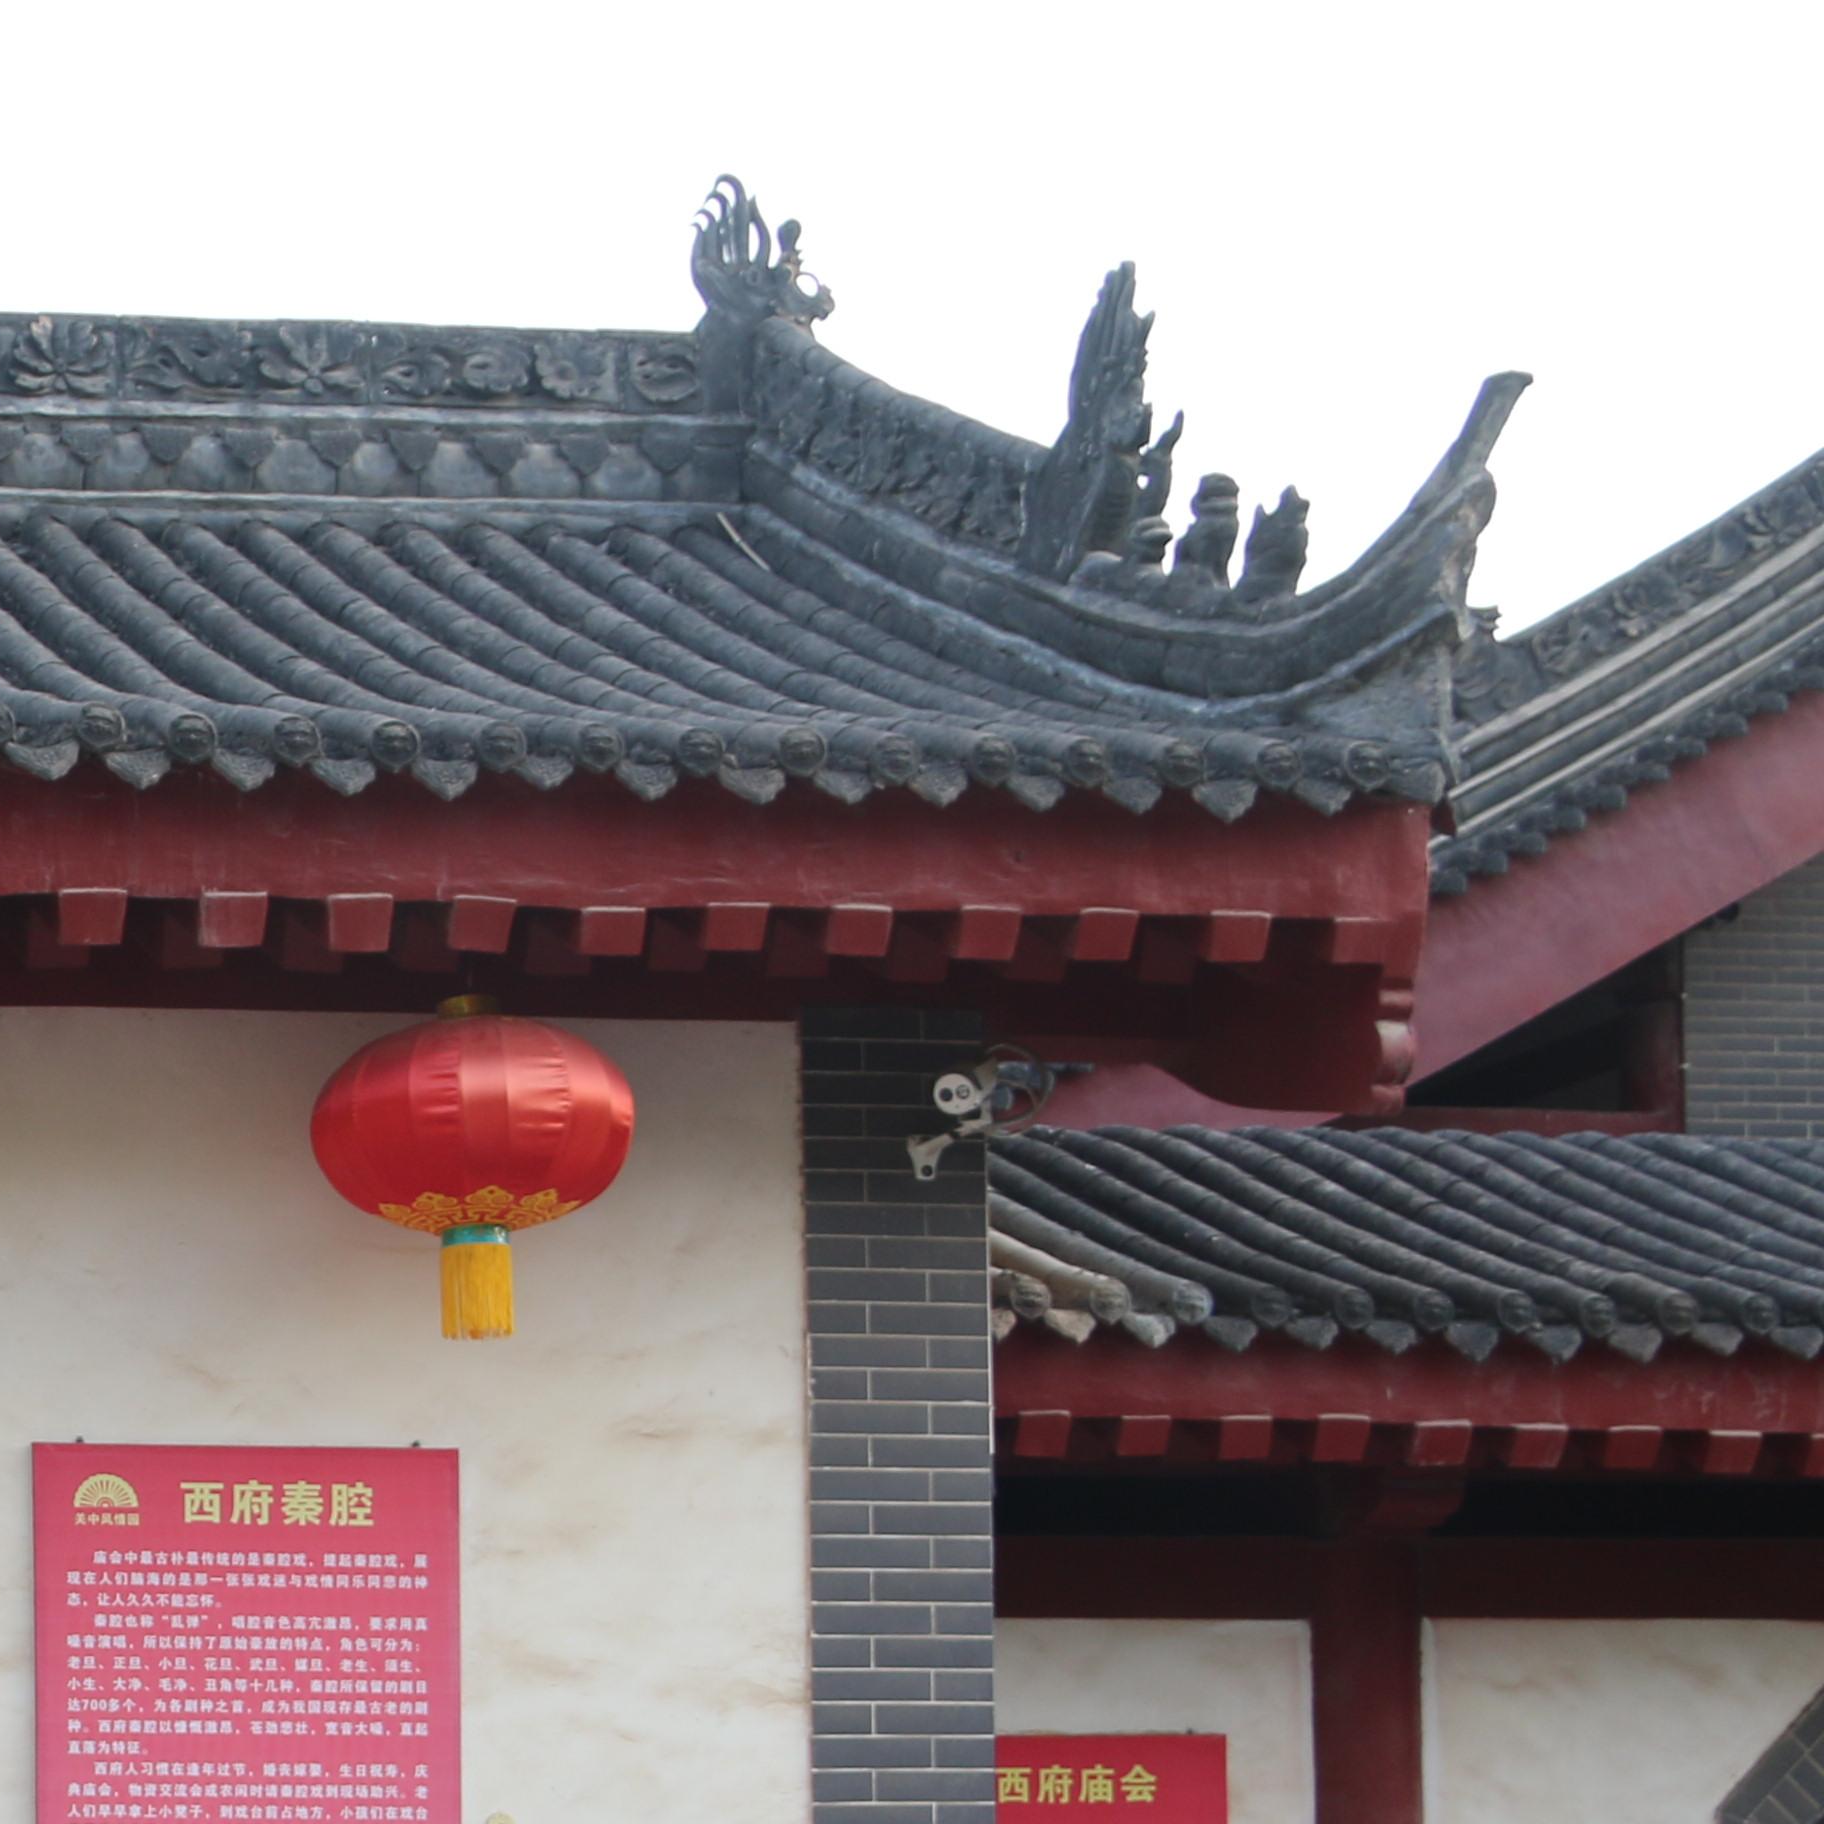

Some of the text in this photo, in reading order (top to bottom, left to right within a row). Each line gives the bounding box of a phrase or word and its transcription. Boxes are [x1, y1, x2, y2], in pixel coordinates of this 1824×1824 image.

[179, 1479, 376, 1527] 西府秦腔
[996, 1764, 1158, 1804] 西府庙会
